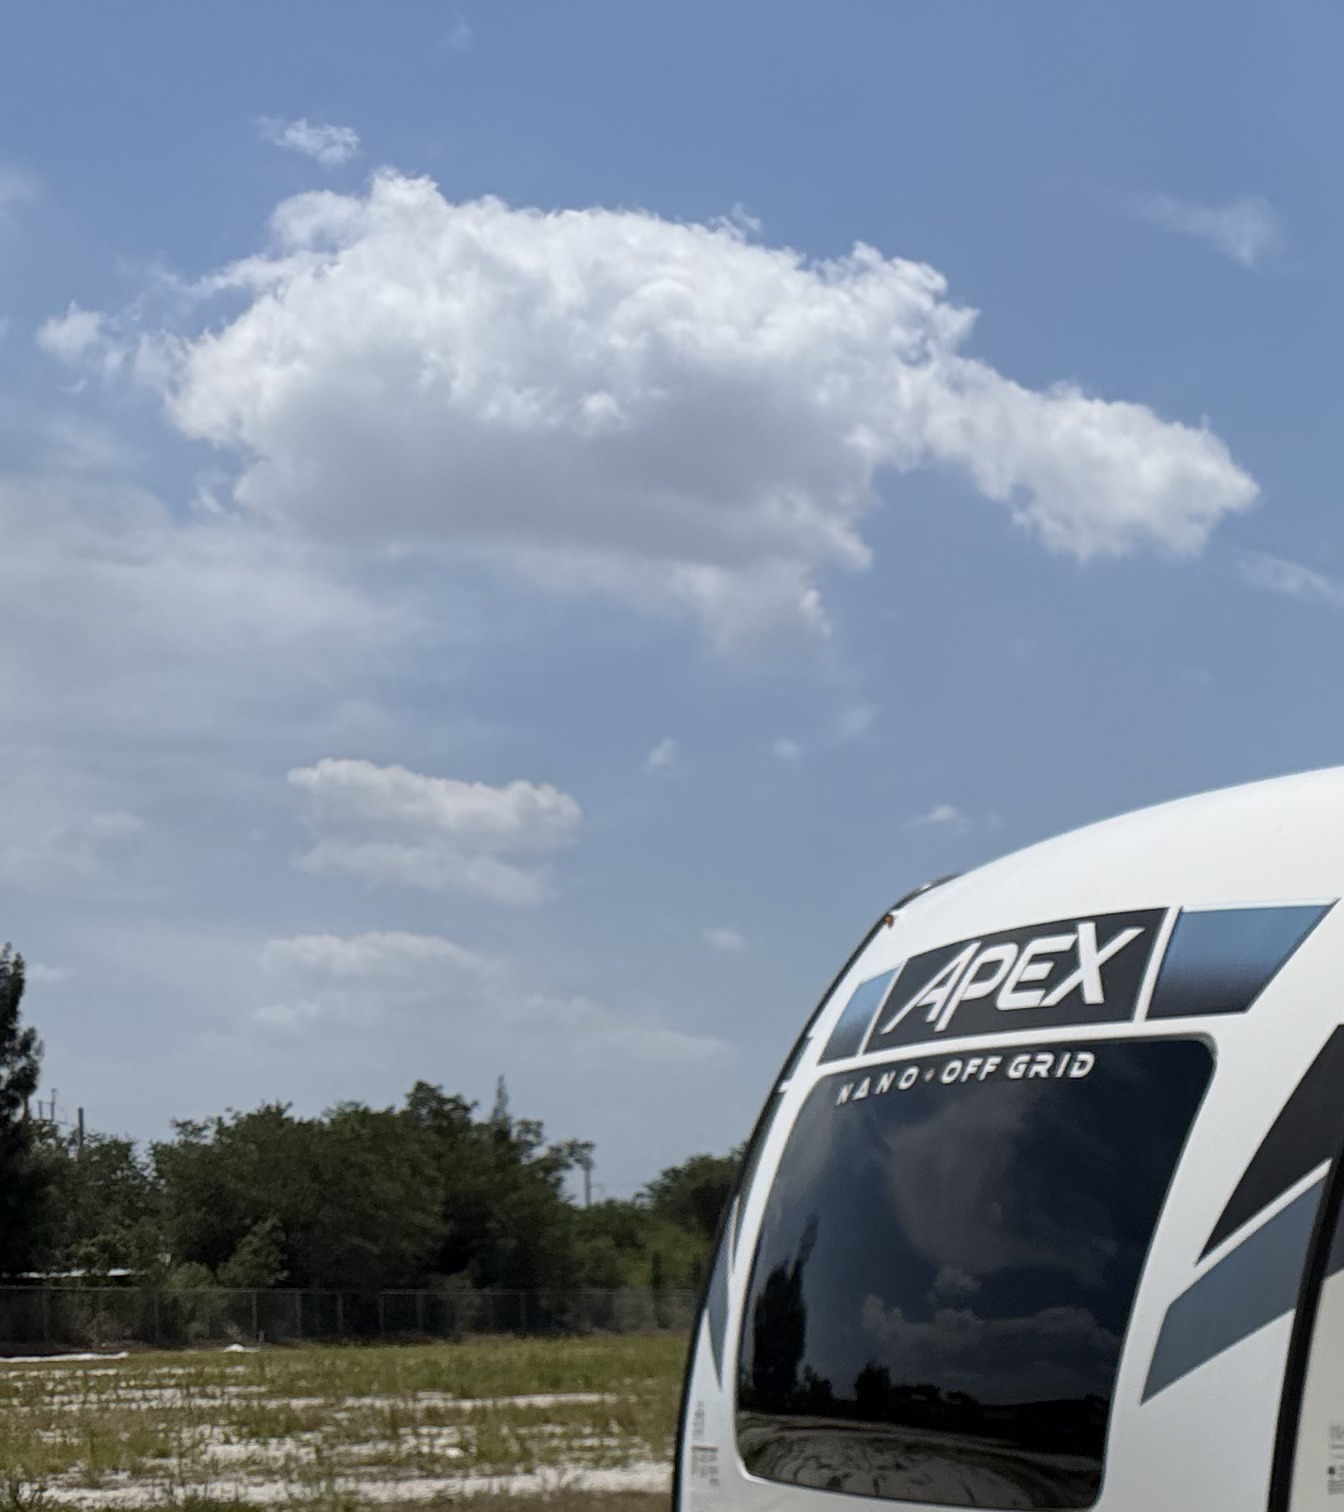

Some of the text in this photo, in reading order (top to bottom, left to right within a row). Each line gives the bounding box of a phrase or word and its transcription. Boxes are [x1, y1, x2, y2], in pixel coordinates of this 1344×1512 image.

[882, 922, 1145, 1034] APEX
[836, 1052, 1095, 1105] NANO OFF GRID
